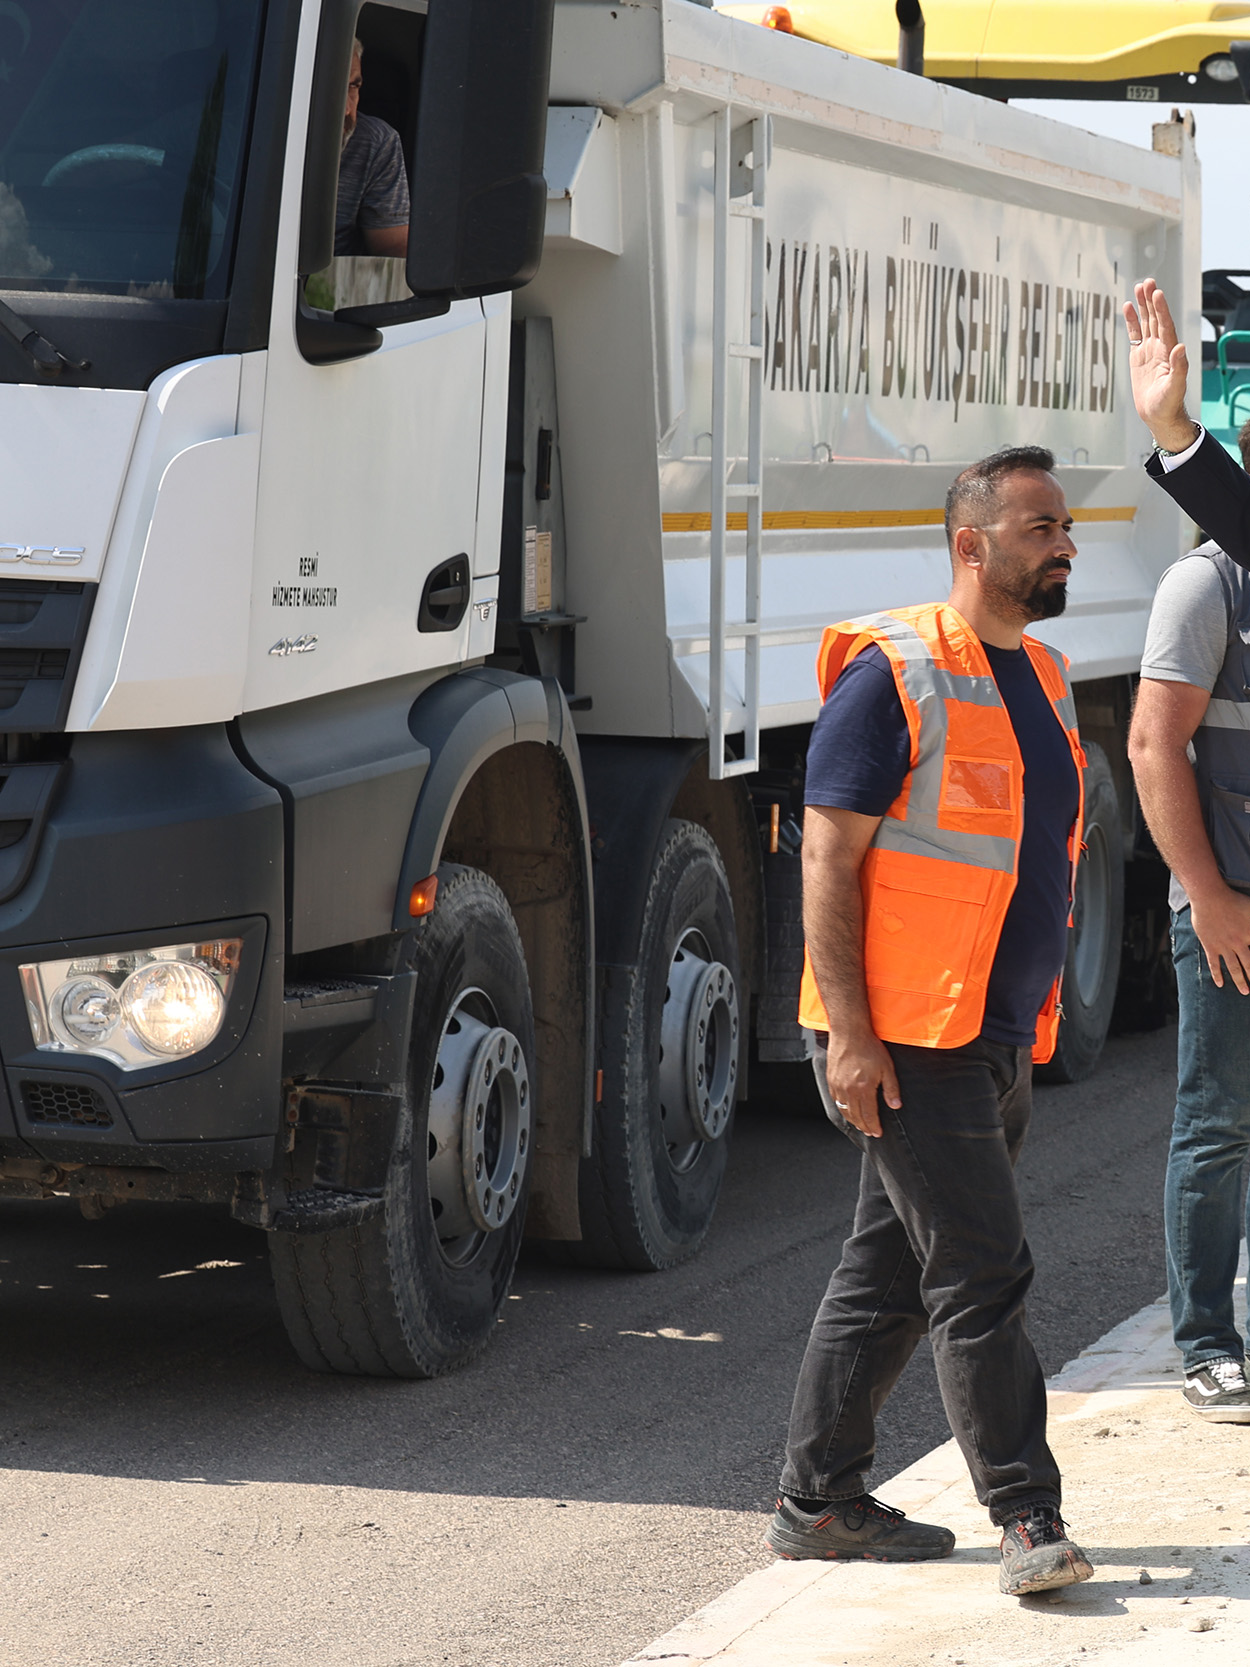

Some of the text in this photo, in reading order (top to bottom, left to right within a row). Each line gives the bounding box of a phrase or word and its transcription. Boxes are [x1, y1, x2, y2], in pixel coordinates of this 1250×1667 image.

[881, 216, 1010, 424] BÜYÜKŞEHİR
[1016, 253, 1118, 414] BELEDİYESİ
[299, 551, 319, 577] RESMİ
[271, 580, 338, 607] HİZMETE MAHSUSTUR
